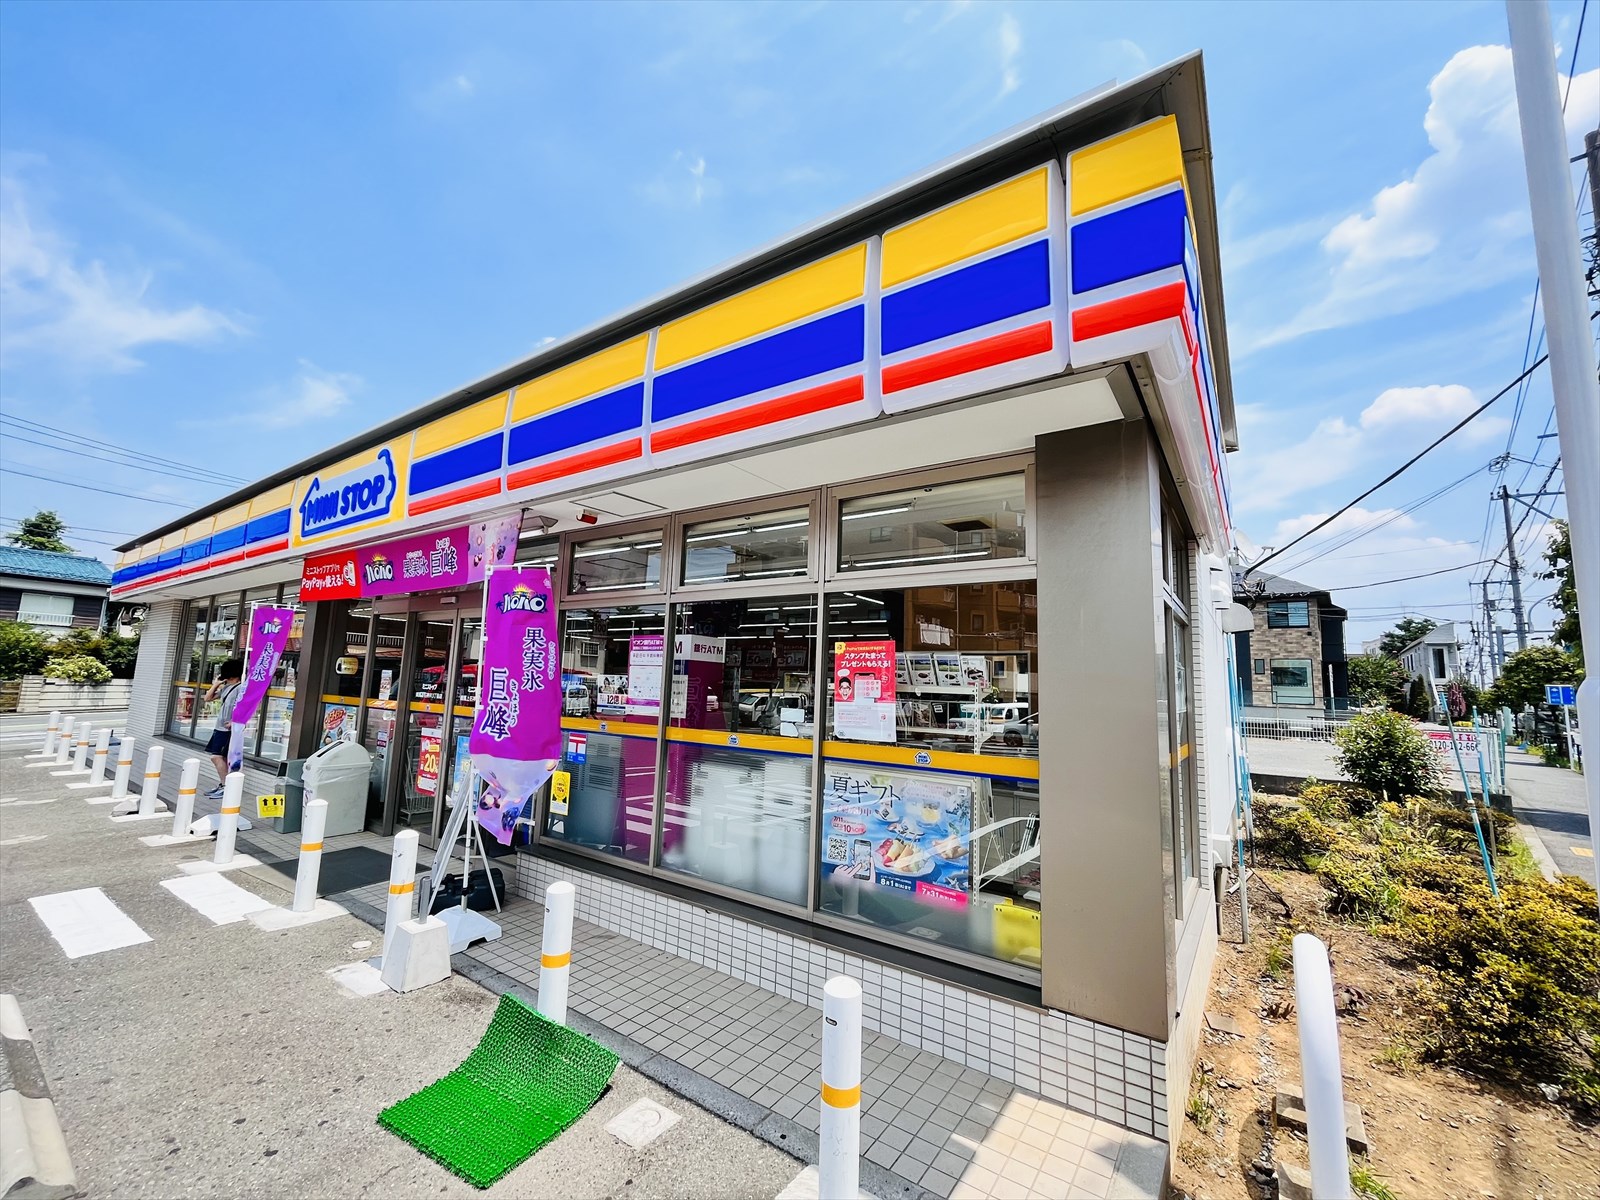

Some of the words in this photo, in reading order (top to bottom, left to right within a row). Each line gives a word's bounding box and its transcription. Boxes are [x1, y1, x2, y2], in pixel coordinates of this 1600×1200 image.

[305, 490, 339, 527] MINI
[340, 474, 385, 516] STOP
[430, 546, 457, 577] 巨峰
[523, 628, 545, 691] 果実氷
[694, 643, 724, 655] 銀行ATM
[840, 660, 891, 669] プレゼントもらえる!
[844, 652, 887, 660] スタンプたまって
[480, 668, 510, 741] 巨峰
[510, 680, 519, 727] きょほう
[829, 774, 901, 808] 夏ギフト
